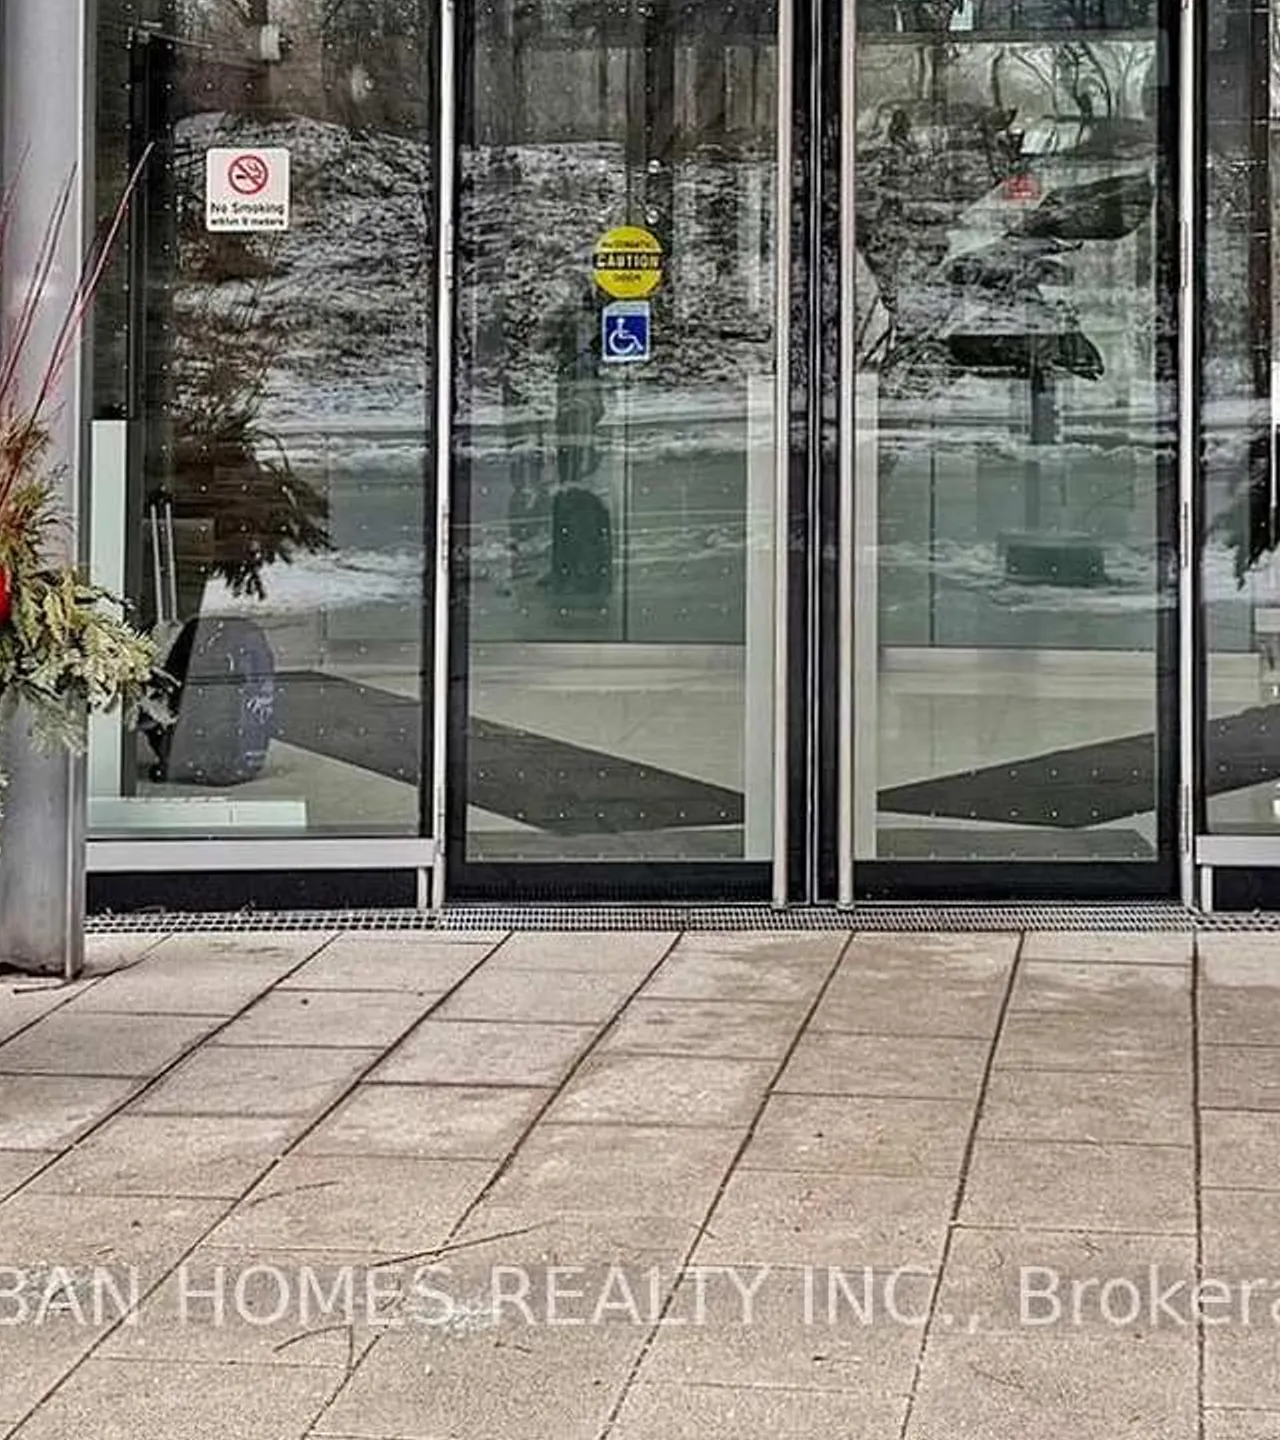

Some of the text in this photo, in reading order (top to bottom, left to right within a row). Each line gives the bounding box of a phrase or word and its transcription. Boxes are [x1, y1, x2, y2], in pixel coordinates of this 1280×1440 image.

[210, 200, 284, 216] No Smoking
[596, 253, 660, 268] CAUTION
